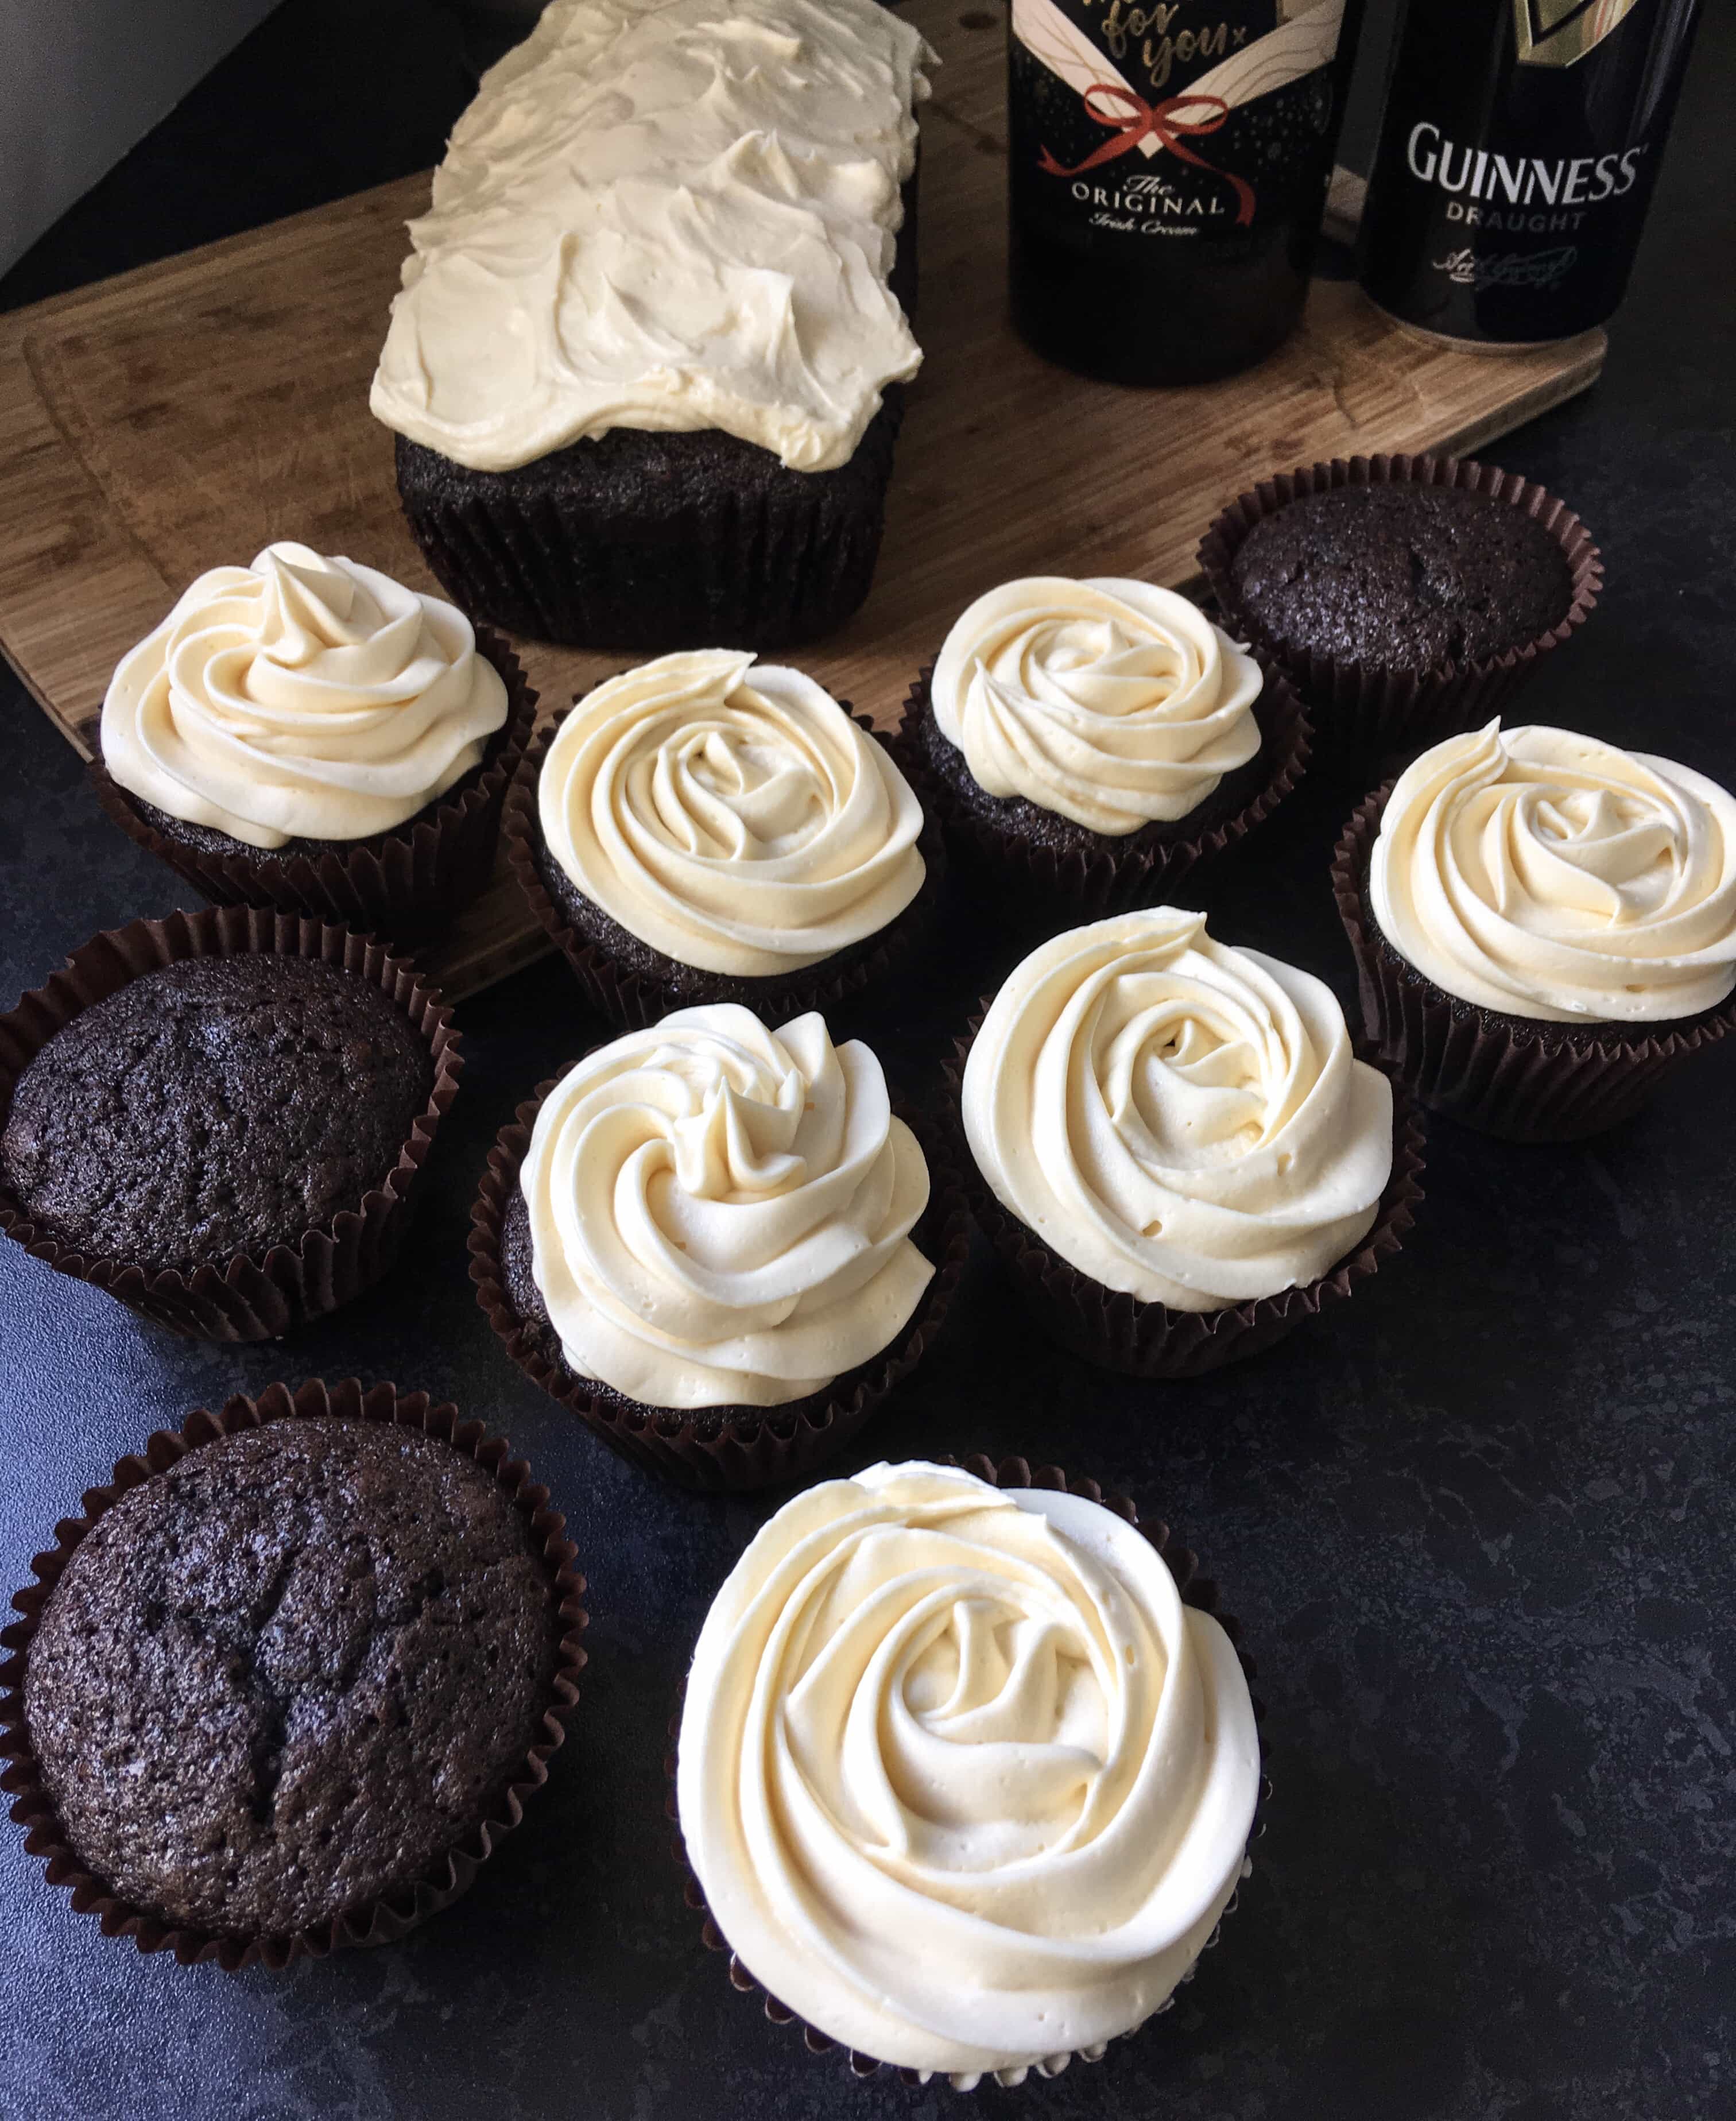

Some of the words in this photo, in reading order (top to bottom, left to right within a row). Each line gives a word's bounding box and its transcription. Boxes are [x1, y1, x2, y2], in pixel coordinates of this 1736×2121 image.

[1102, 0, 1179, 59] for
[1142, 22, 1227, 87] you
[1122, 175, 1175, 195] The
[1407, 122, 1641, 205] GUINNESS
[1071, 181, 1225, 215] ORIGINAL
[1446, 202, 1587, 232] DRAUGHT
